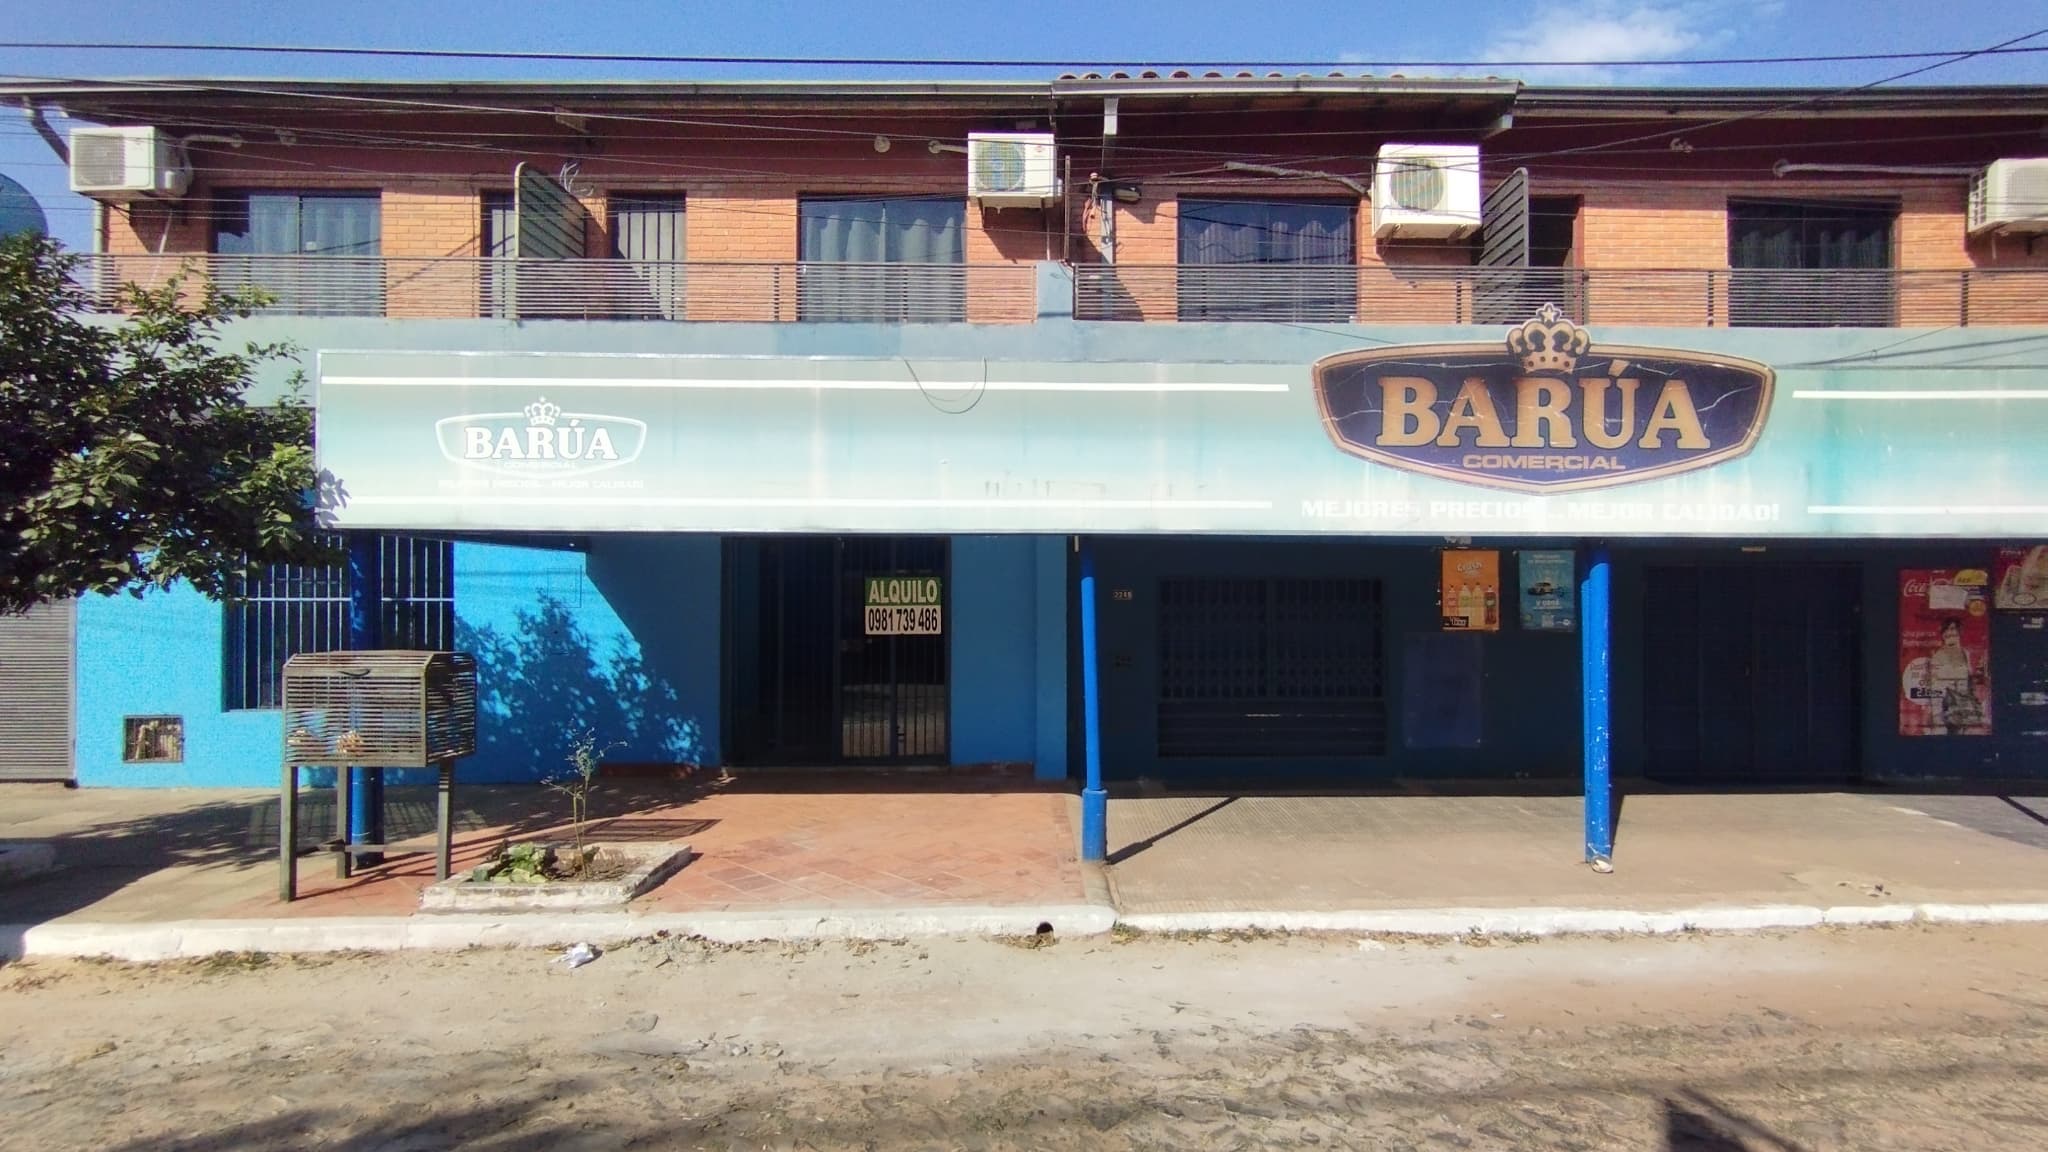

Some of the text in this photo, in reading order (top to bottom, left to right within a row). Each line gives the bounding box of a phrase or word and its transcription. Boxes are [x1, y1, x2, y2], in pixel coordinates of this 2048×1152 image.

[1376, 359, 1712, 450] BARÚA
[464, 419, 620, 461] BARÚA
[1462, 454, 1626, 471] COMERCIAL
[1568, 501, 1653, 521] MEJOR
[868, 579, 938, 604] ALQUILO
[868, 608, 938, 632] 0981 739 486
